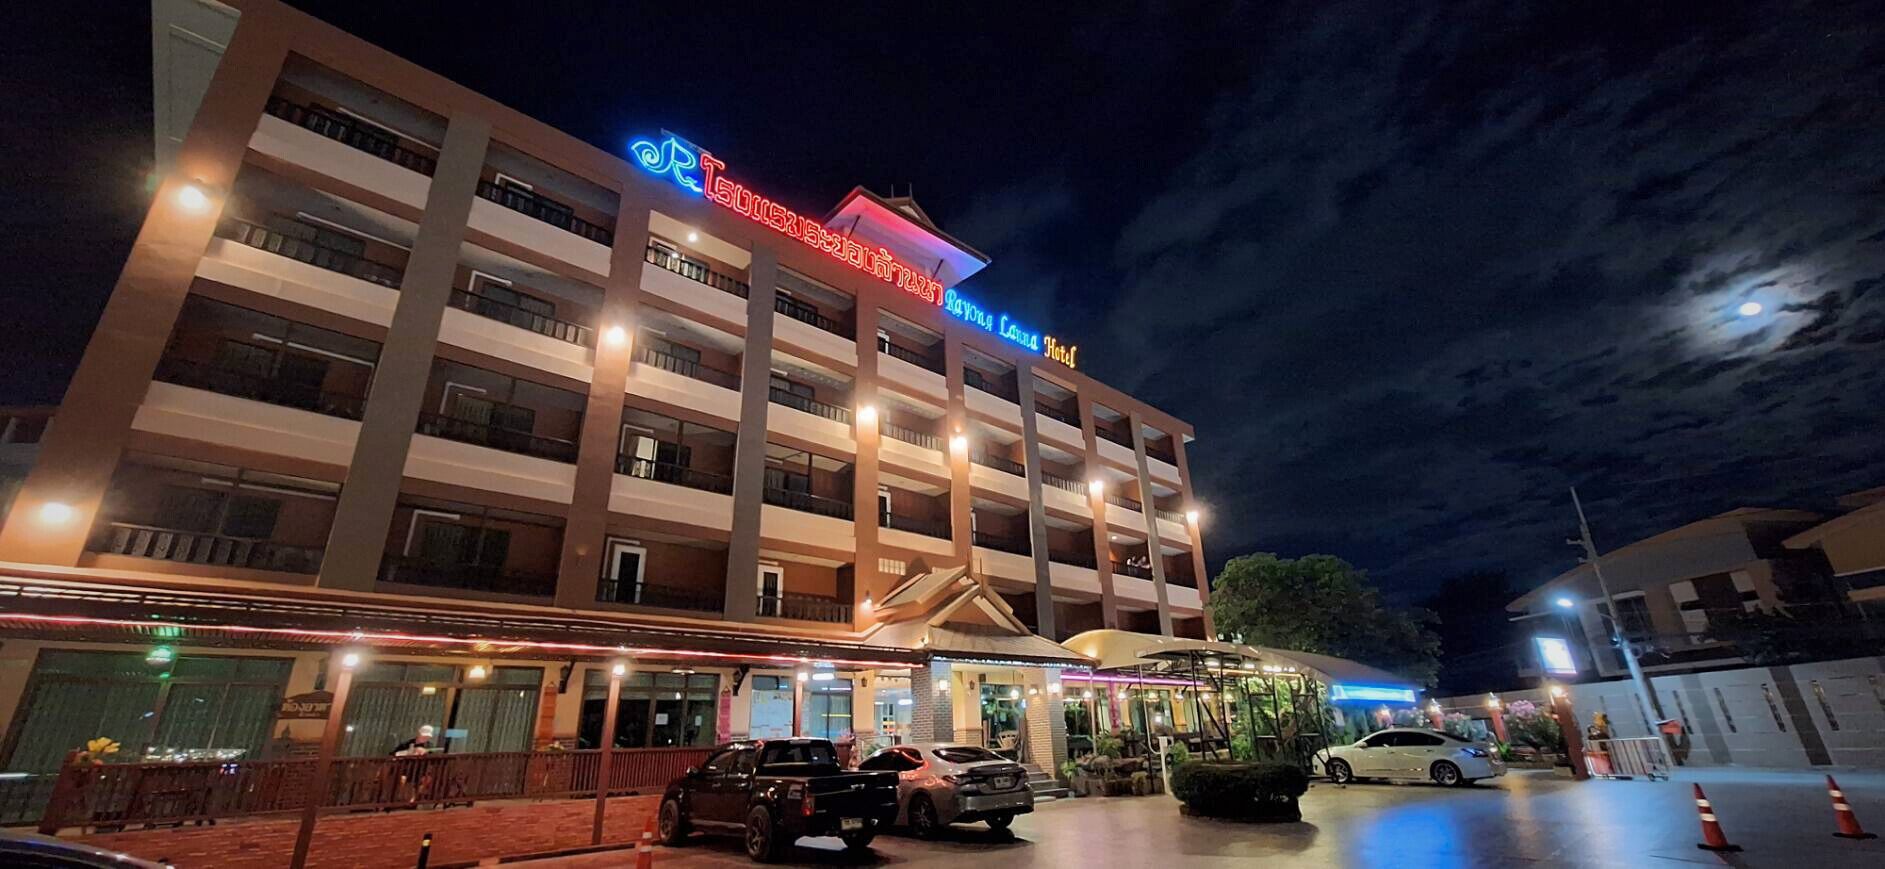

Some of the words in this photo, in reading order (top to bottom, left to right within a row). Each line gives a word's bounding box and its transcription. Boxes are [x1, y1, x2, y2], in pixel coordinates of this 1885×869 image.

[700, 153, 943, 306] โรงแรมระยองล้านนา
[945, 289, 993, 332] Rayong
[999, 315, 1039, 351] Lanna
[1044, 336, 1077, 369] Hotel
